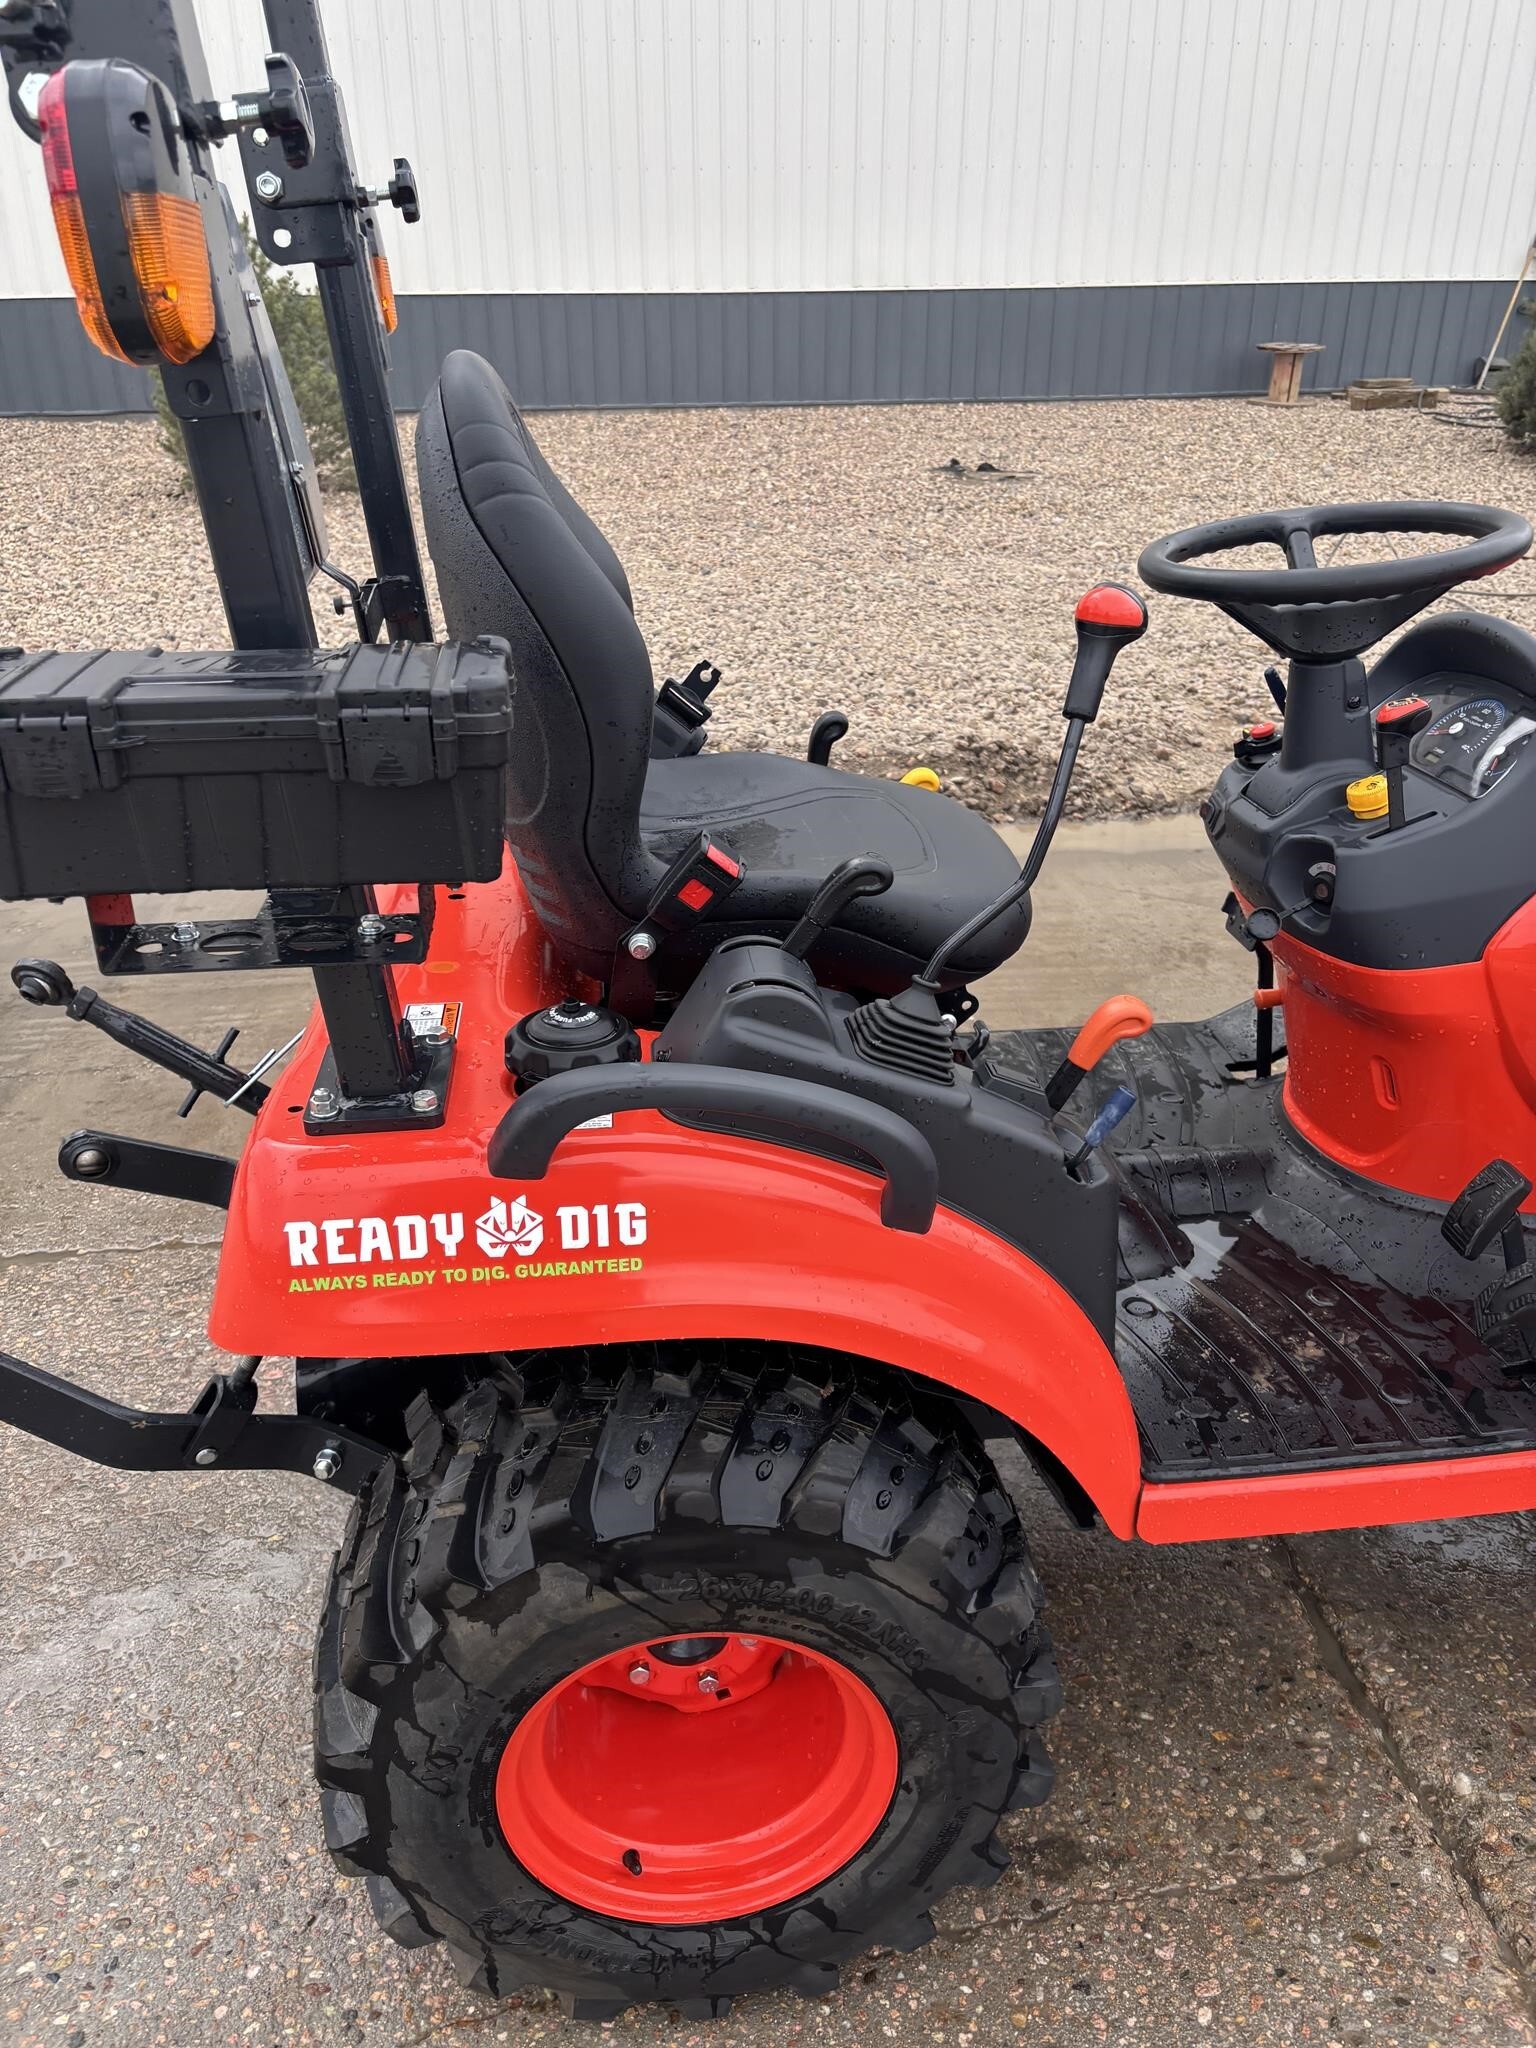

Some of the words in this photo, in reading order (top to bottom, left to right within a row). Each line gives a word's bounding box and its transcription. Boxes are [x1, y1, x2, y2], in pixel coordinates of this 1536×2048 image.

[283, 1212, 465, 1267] READY
[555, 1202, 647, 1249] DIG
[289, 1275, 367, 1293] ALWAYS
[373, 1270, 436, 1288] READY
[442, 1268, 467, 1284] TO
[472, 1265, 510, 1282] DIG.
[515, 1257, 643, 1279] GUARANTEED
